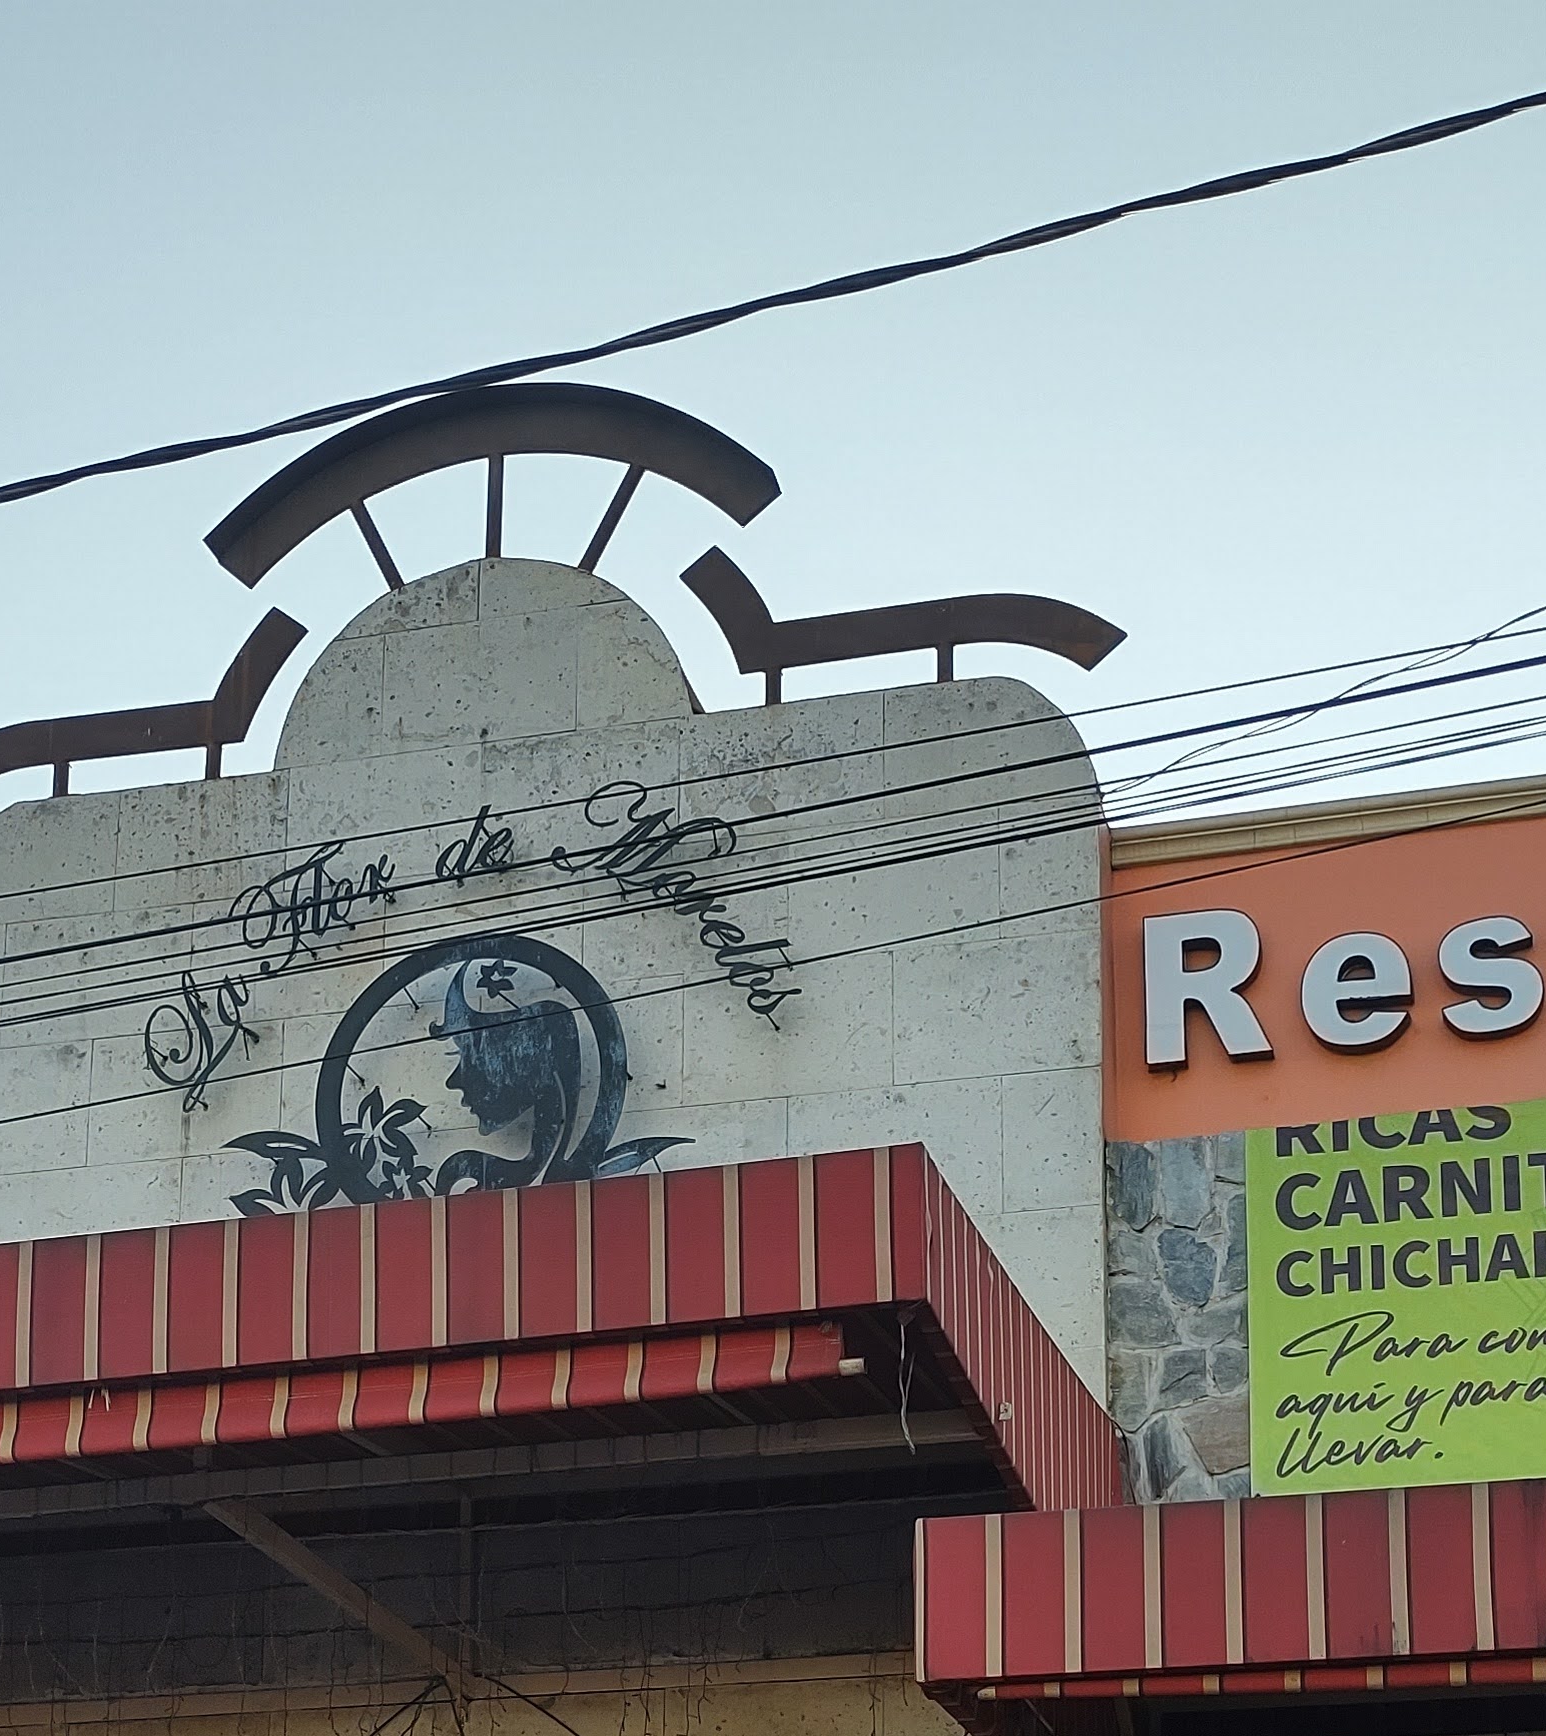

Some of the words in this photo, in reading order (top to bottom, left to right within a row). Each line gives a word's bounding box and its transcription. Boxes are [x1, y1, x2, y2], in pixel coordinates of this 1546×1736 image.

[228, 841, 395, 975] Flor
[435, 804, 514, 884] de
[551, 781, 802, 1014] Morelos
[1279, 1310, 1468, 1377] Para
[1385, 1383, 1445, 1433] y
[1275, 1426, 1445, 1479] llevar.
